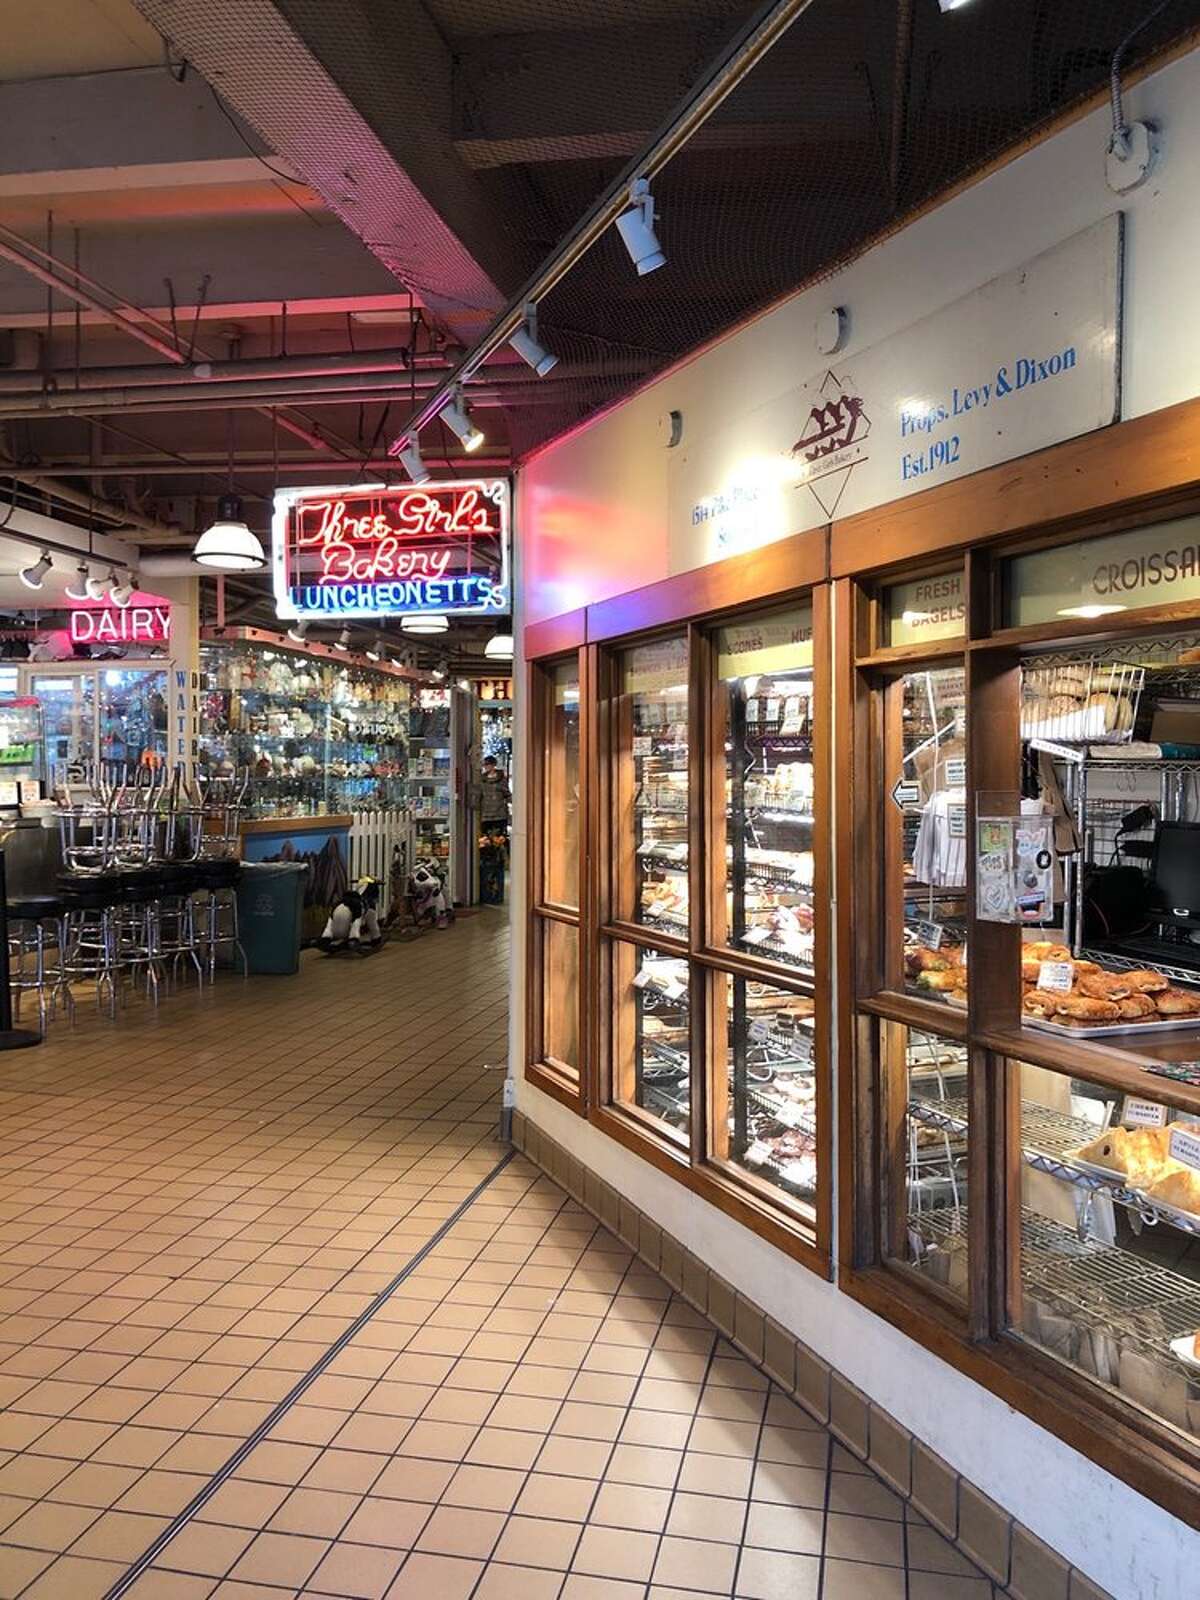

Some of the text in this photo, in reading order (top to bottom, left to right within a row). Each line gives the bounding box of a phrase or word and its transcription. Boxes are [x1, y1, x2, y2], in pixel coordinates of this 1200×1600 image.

[900, 347, 1077, 437] Props. Levy & Dixon
[299, 490, 495, 546] Three Girls
[319, 537, 452, 584] Bakery
[1092, 545, 1200, 596] CROISSA
[914, 577, 961, 602] FRESH
[71, 607, 172, 642] DAIRY
